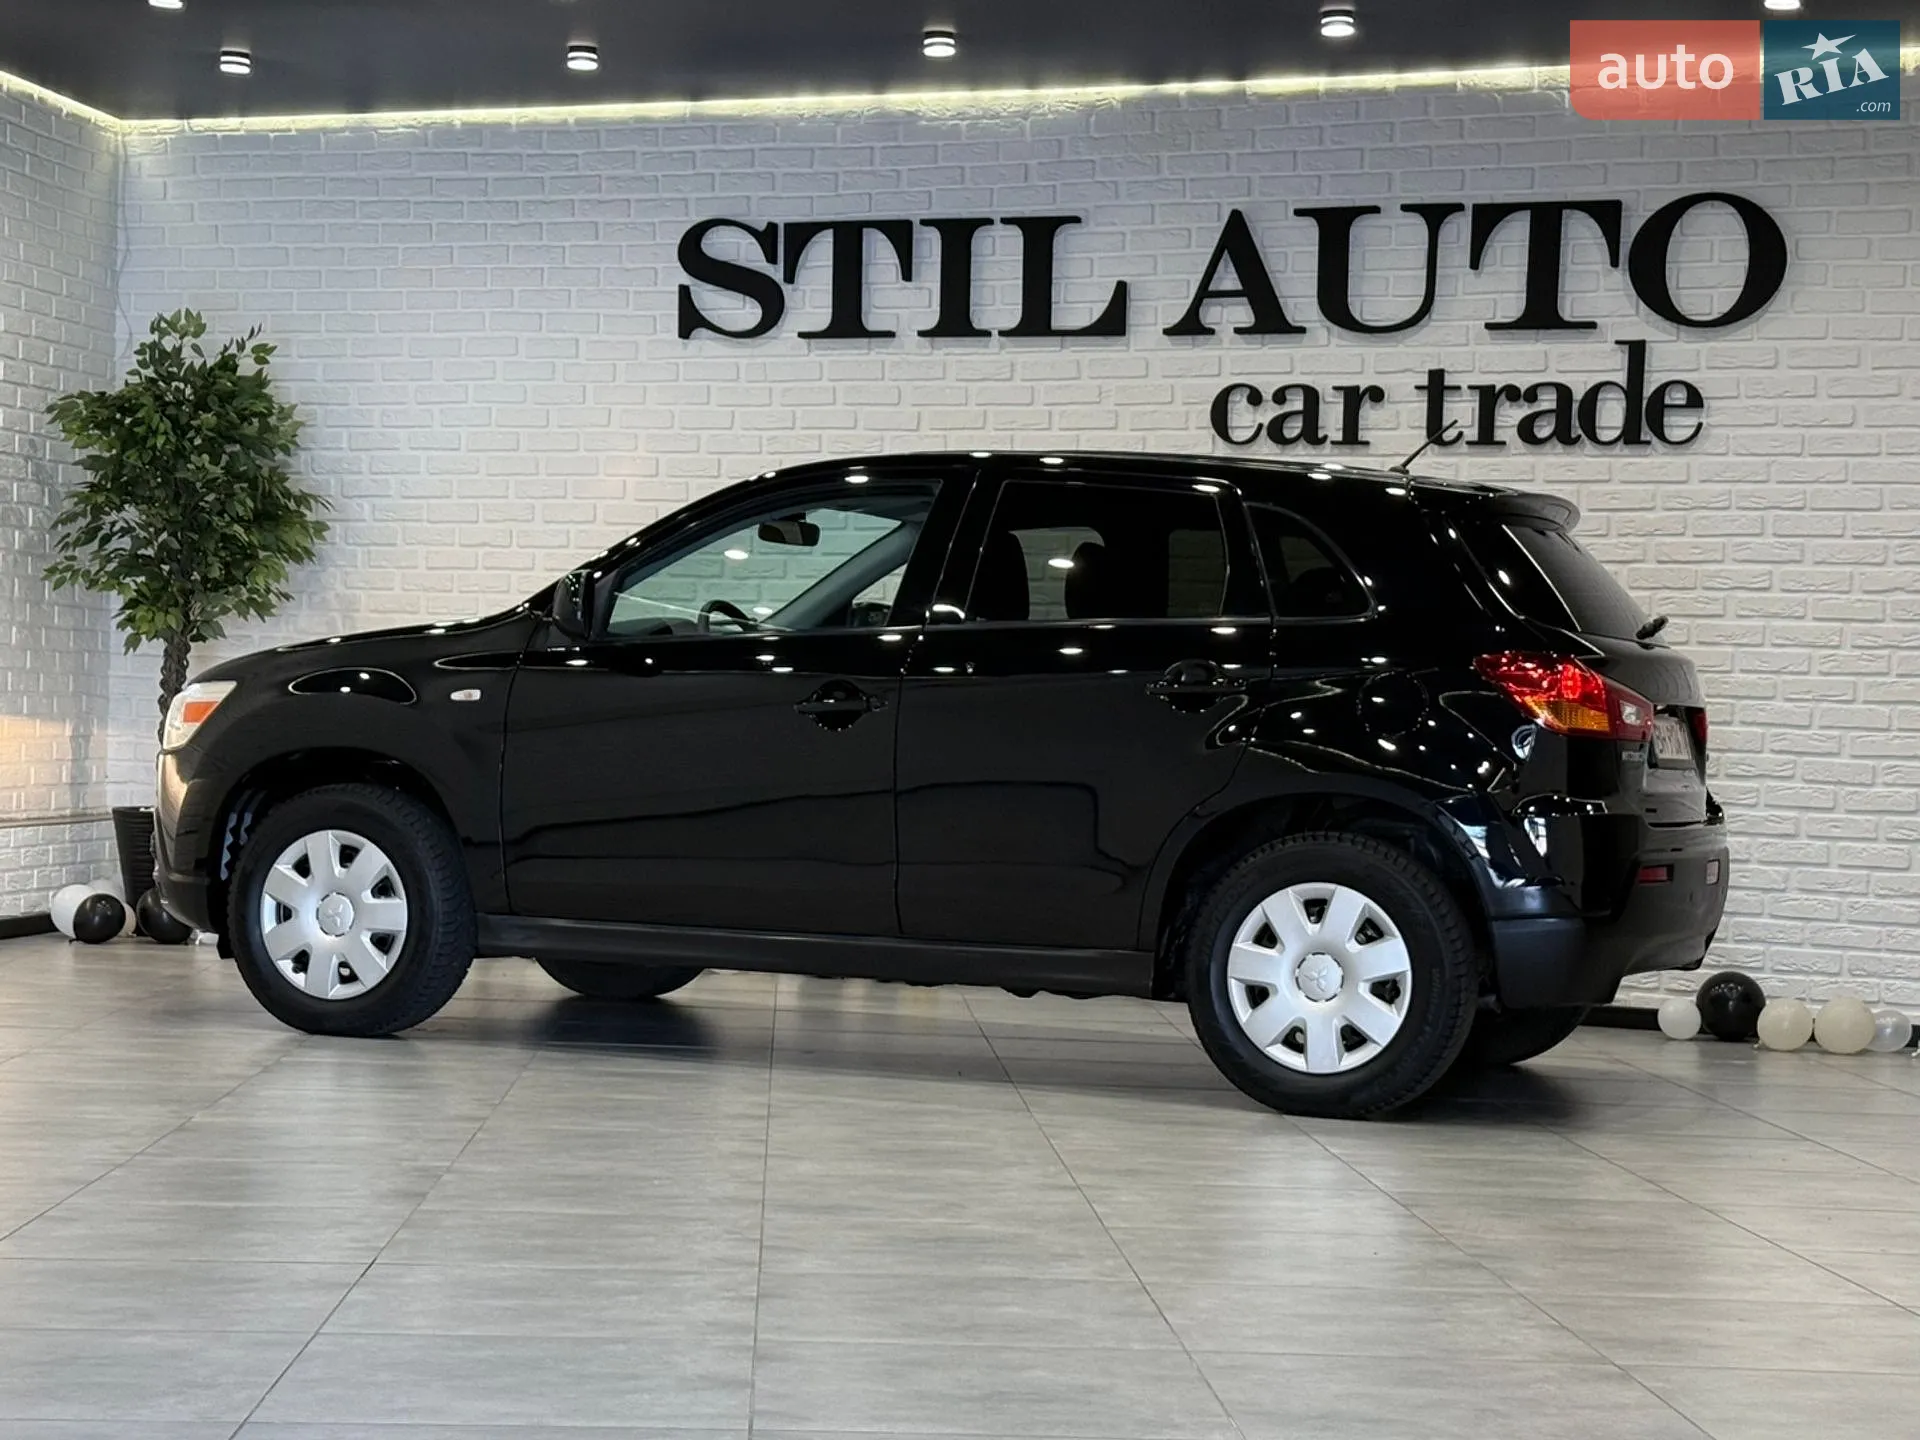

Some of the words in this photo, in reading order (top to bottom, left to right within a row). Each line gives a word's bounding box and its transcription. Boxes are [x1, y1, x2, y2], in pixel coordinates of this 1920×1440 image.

[678, 216, 1128, 339] STIL
[1162, 192, 1788, 337] AUTO
[1210, 383, 1385, 446] car
[1414, 340, 1704, 447] trade
